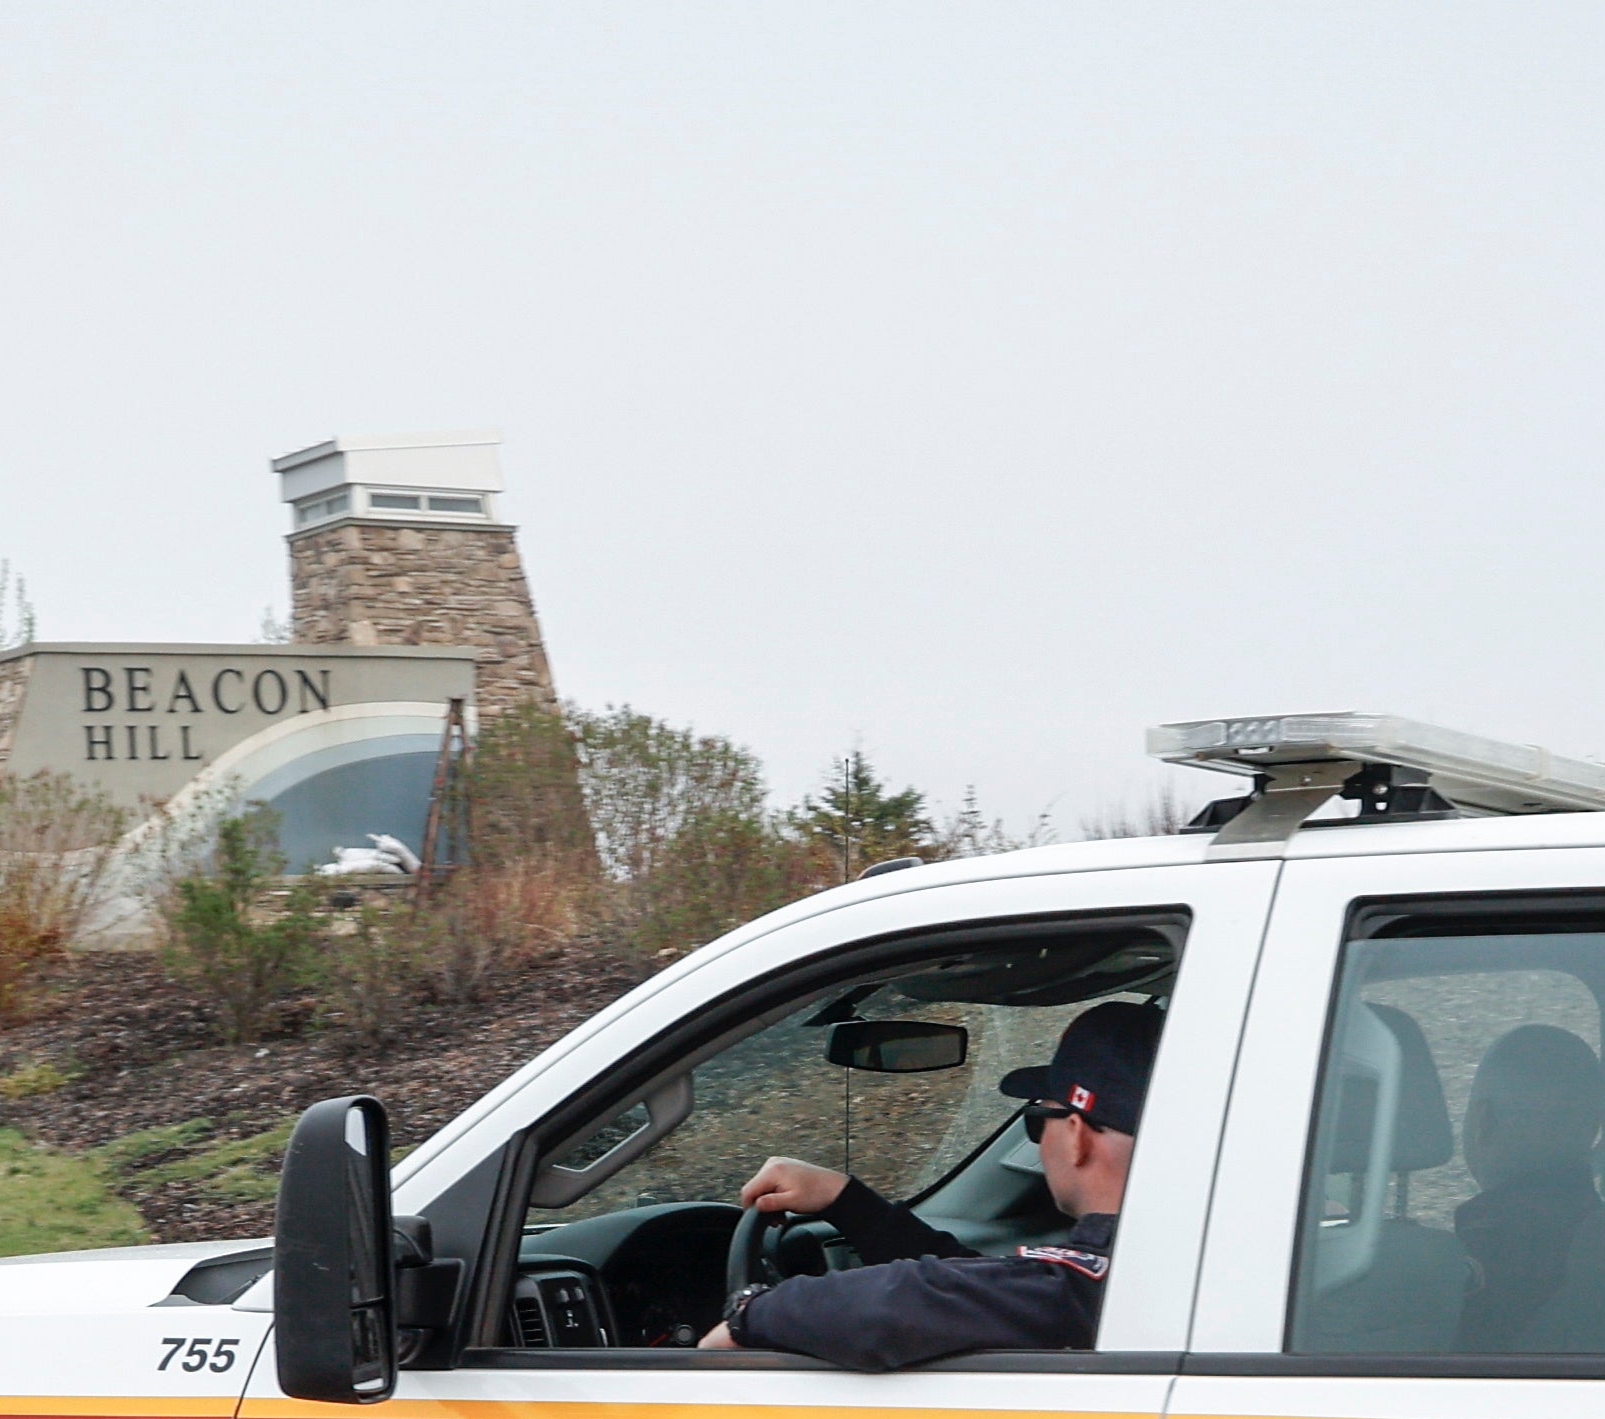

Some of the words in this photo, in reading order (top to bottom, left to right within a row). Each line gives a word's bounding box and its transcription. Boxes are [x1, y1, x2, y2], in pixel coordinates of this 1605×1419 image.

[80, 666, 331, 715] BEACON
[84, 724, 205, 762] HILL
[157, 1337, 241, 1373] 755
